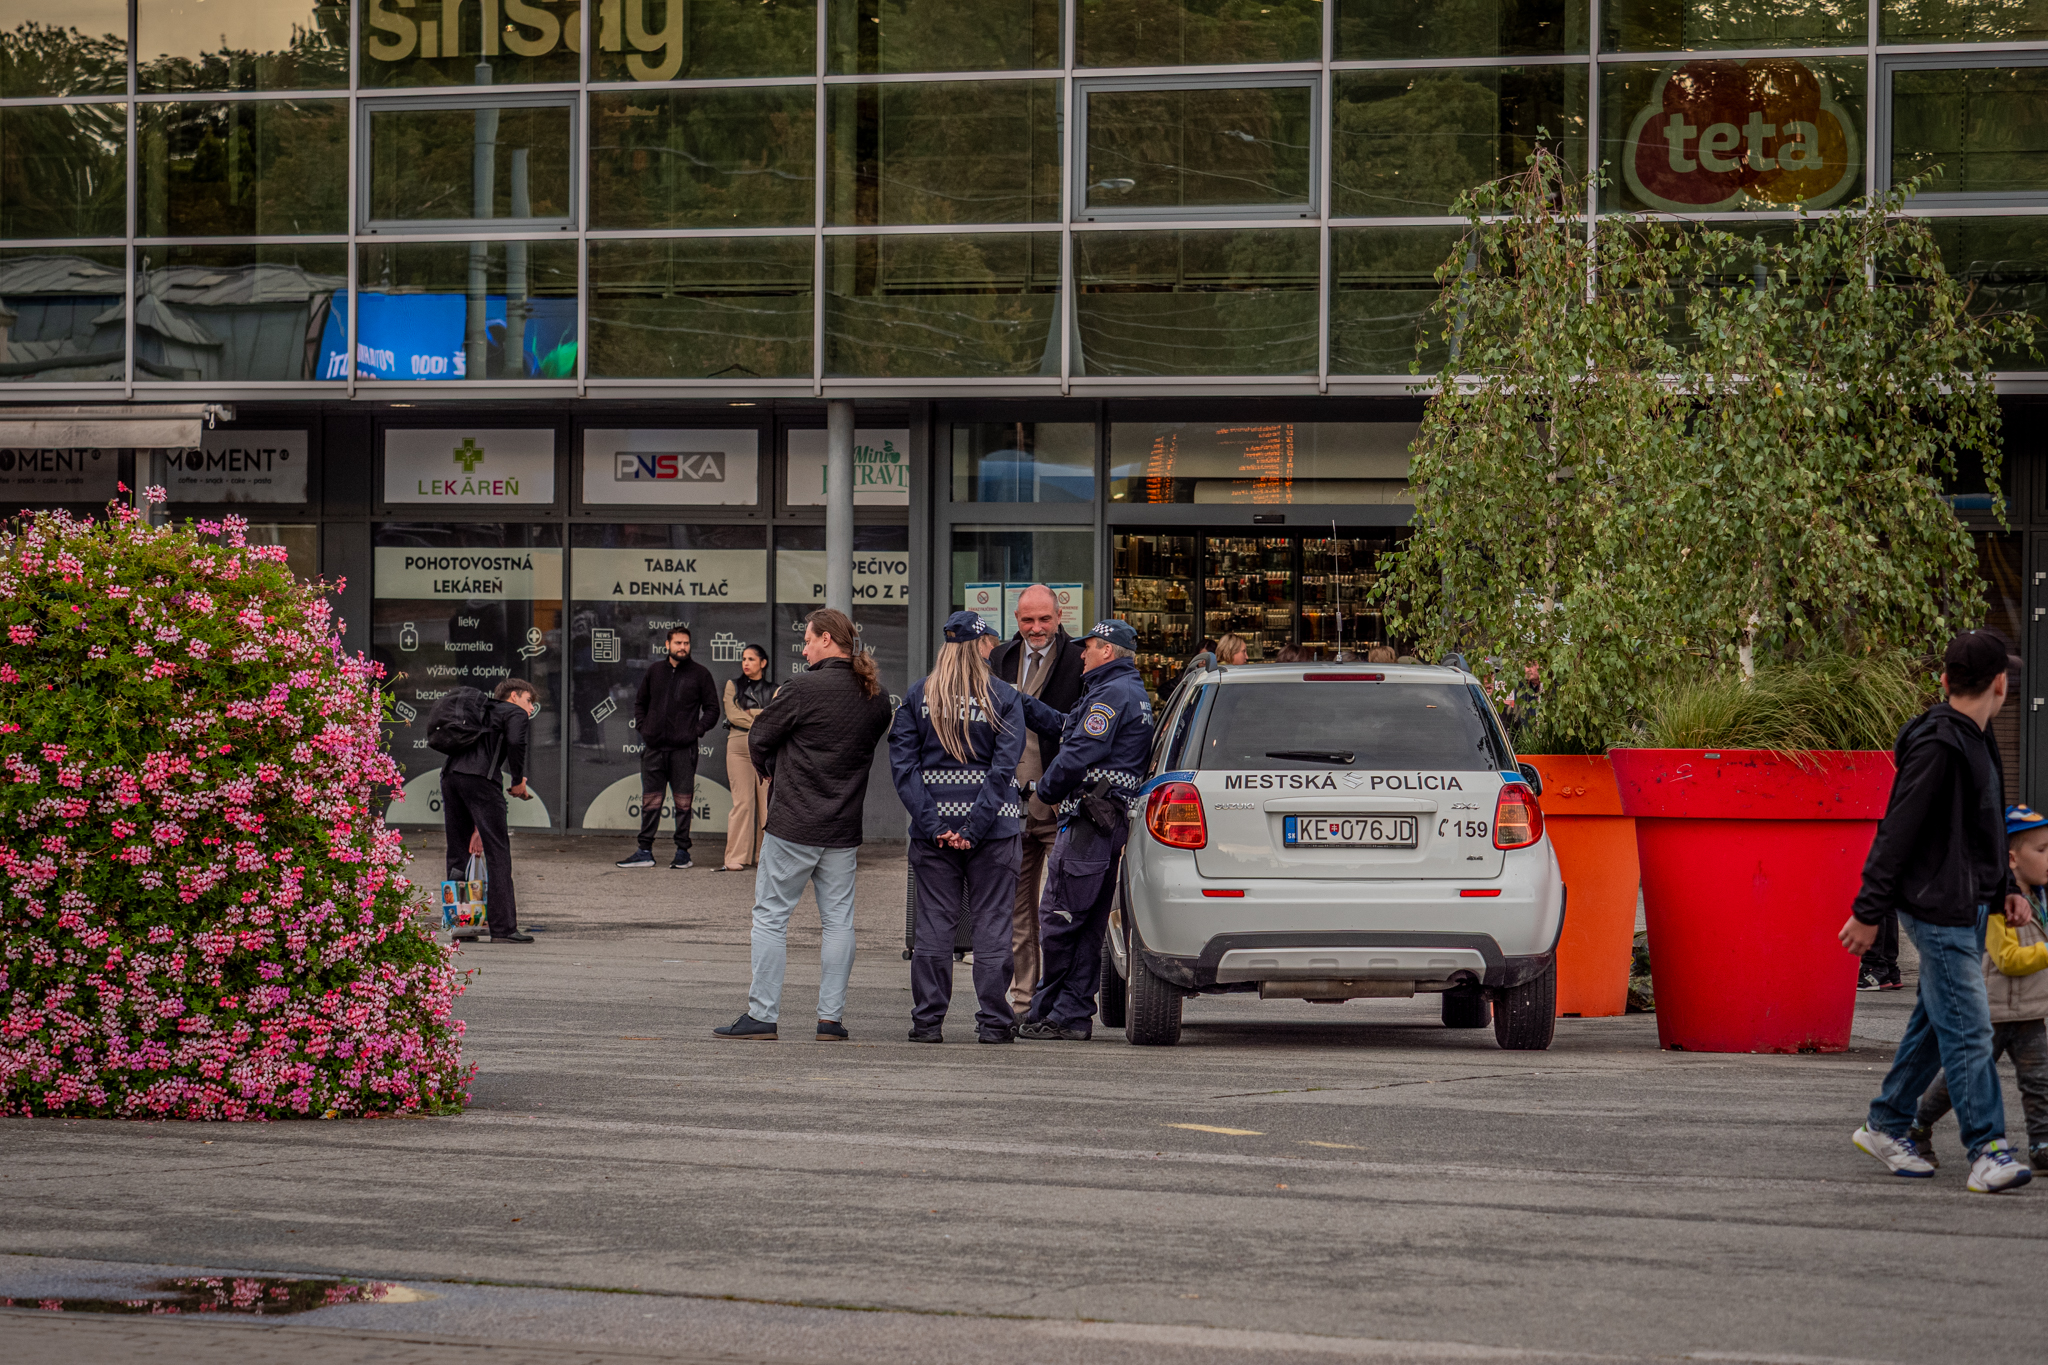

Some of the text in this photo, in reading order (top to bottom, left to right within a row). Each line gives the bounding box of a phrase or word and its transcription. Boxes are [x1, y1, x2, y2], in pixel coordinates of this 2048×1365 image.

[1663, 111, 1823, 173] teta
[0, 448, 88, 471] OMENT
[616, 455, 722, 479] PNSKA
[405, 553, 533, 571] POHOTOVOSTNÁ
[644, 558, 697, 573] TABAK
[433, 576, 502, 594] LEKÁREŇ
[612, 579, 728, 597] A DENNÁ TLAČ
[883, 585, 893, 598] Z
[458, 616, 479, 629] lieky
[444, 641, 493, 652] kozmetika
[427, 665, 511, 678] výživové doplnky
[1225, 772, 1463, 791] MESTSKÁ POLÍCIA
[1451, 802, 1480, 810] SX4
[1301, 820, 1327, 840] KE
[1453, 820, 1488, 838] 159
